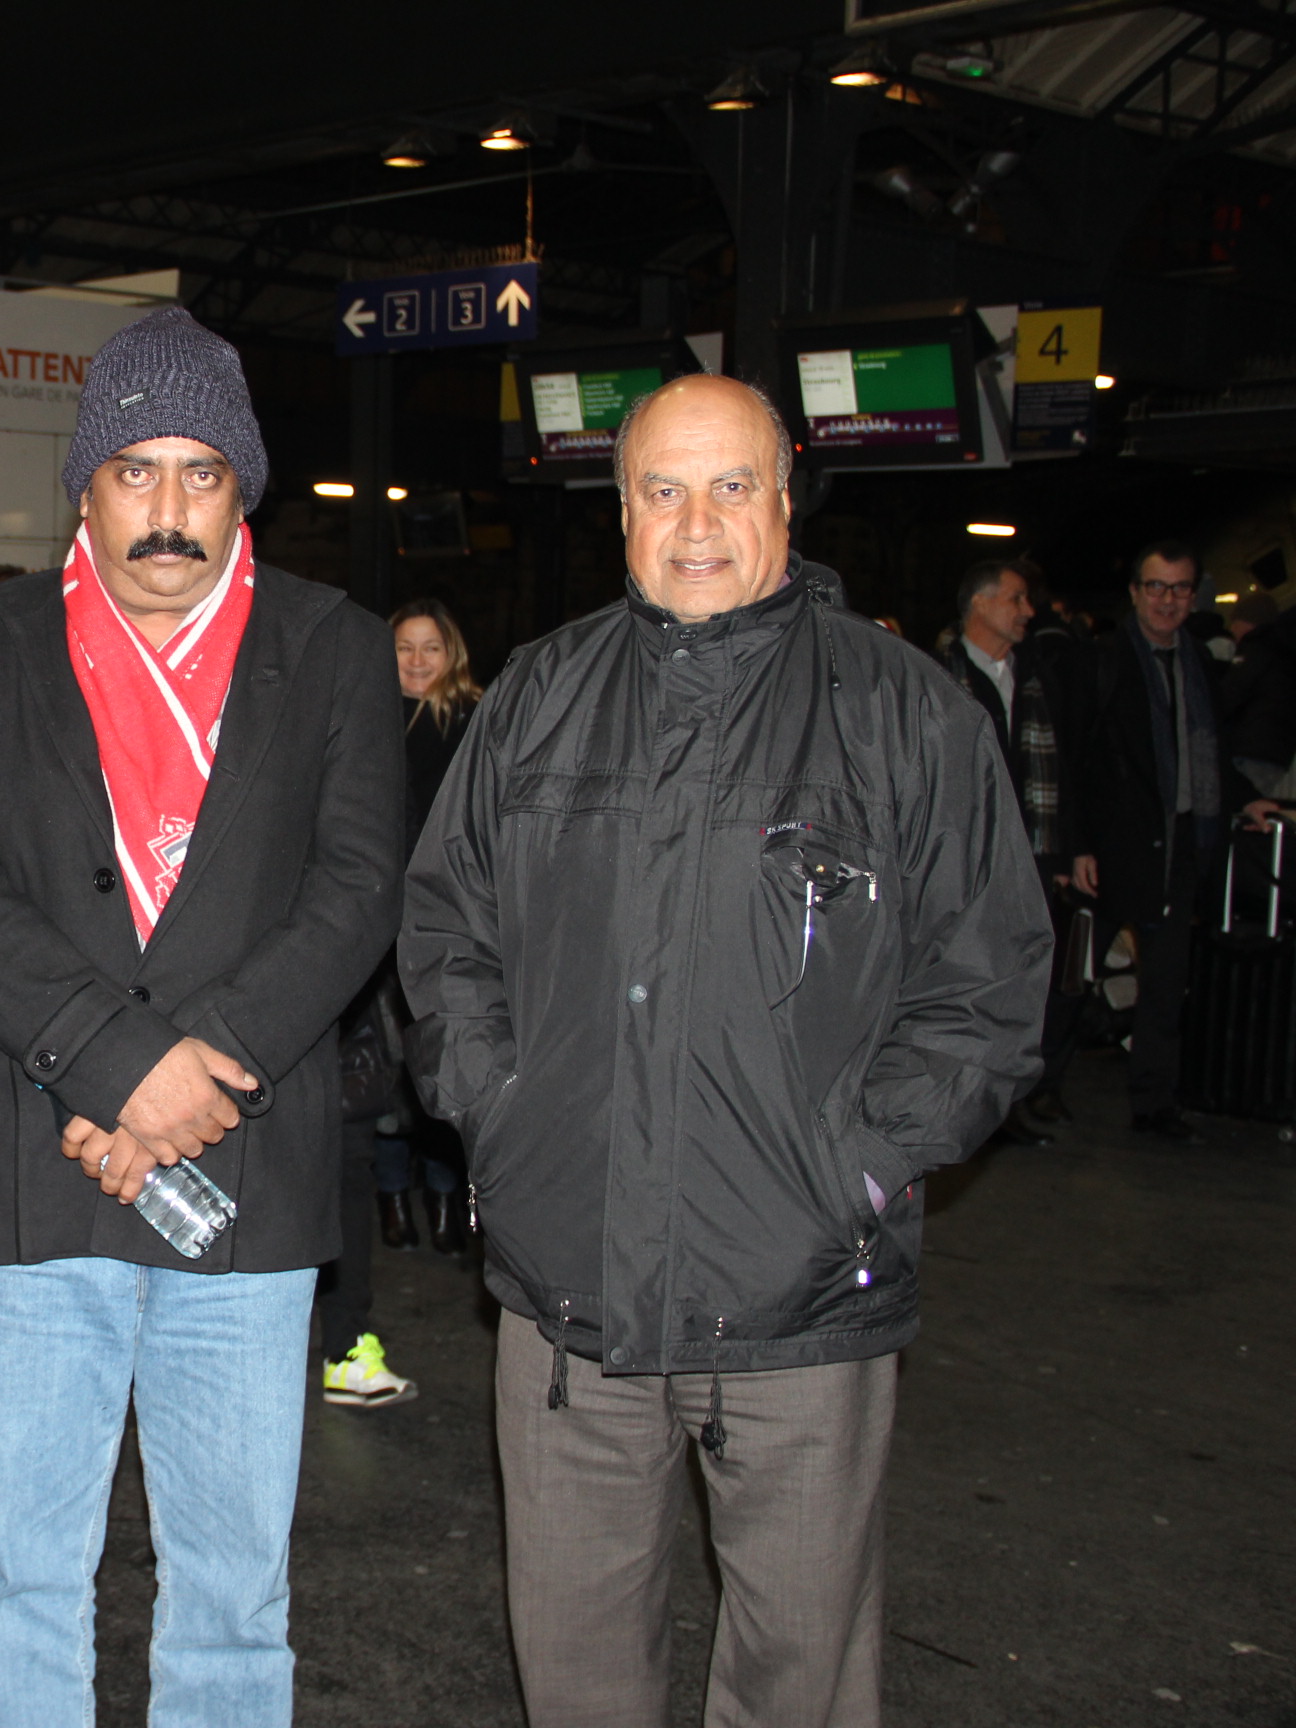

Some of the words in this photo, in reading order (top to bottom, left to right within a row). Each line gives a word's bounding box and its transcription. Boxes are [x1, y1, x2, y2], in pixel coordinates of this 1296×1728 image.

[395, 308, 407, 330] 2
[460, 301, 473, 325] 3
[1038, 323, 1069, 366] 4
